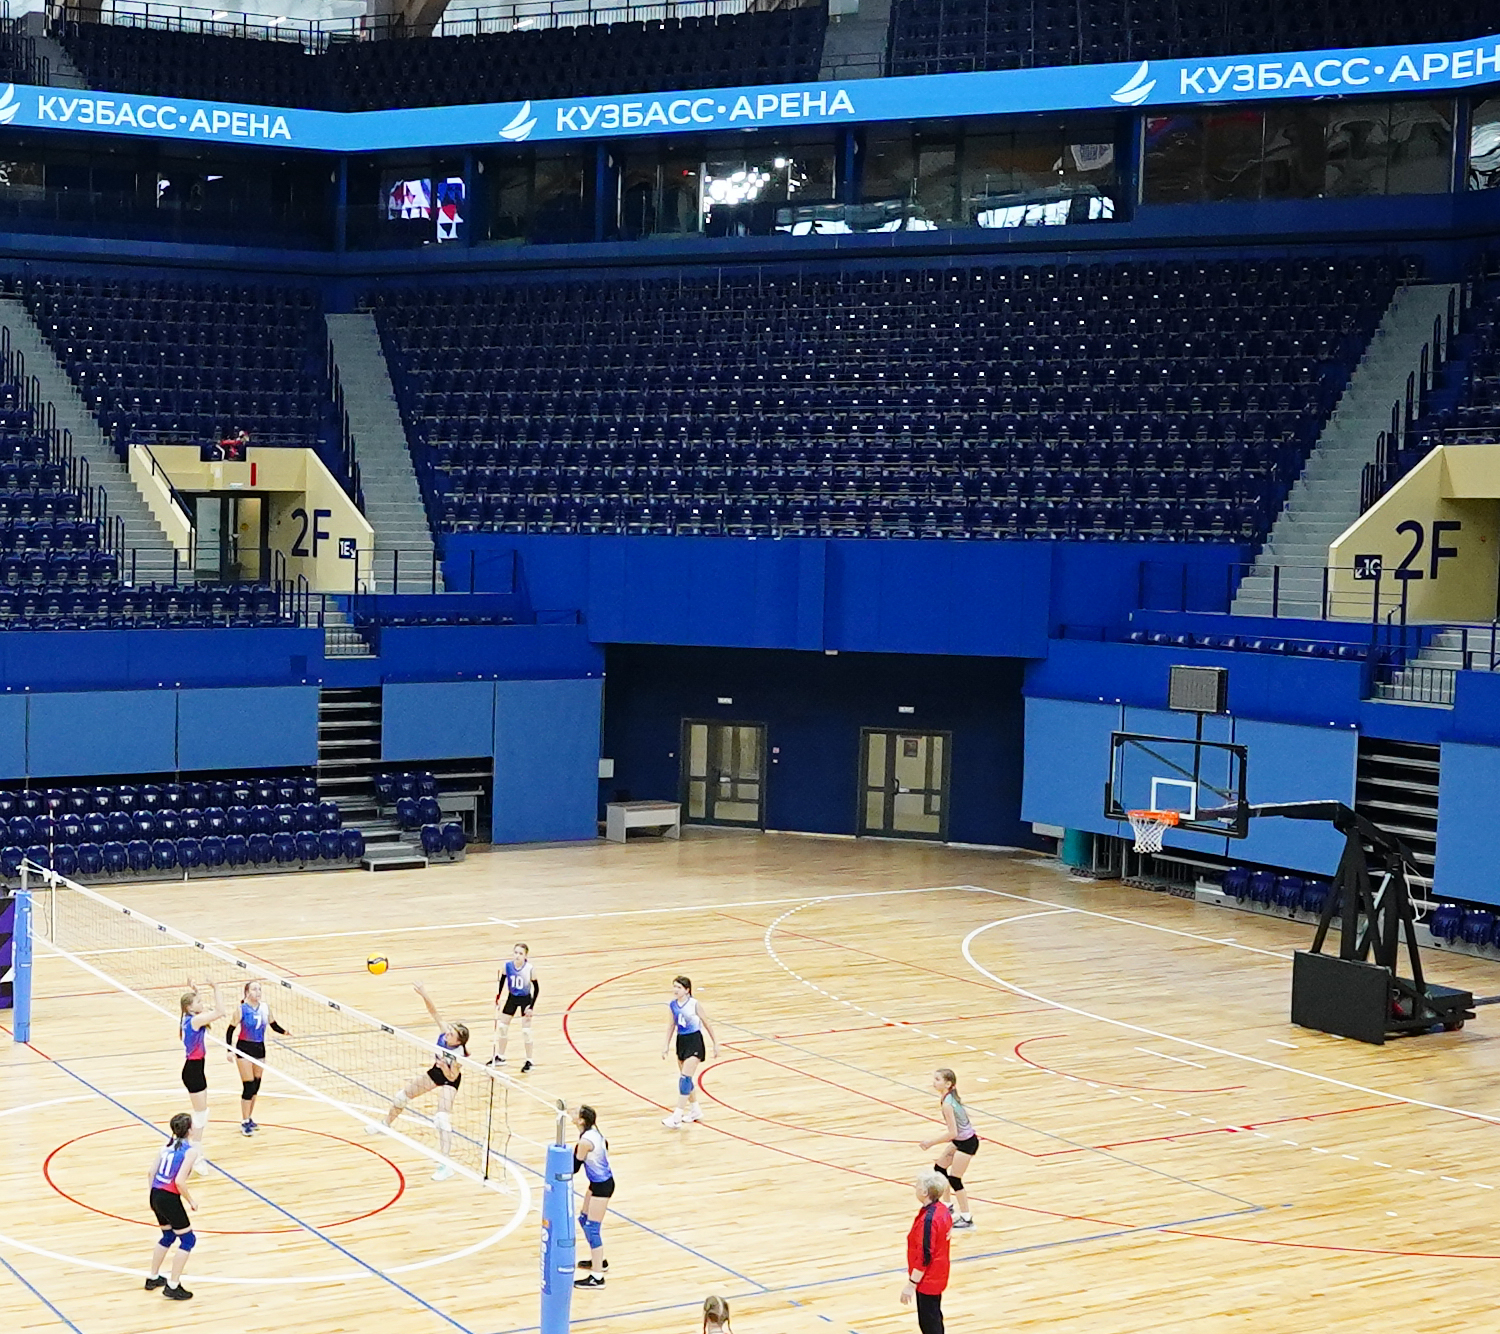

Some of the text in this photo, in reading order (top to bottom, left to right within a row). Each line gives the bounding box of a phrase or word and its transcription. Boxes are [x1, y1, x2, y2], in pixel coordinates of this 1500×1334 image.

[291, 507, 332, 558] 2F
[339, 541, 351, 555] 1E
[1394, 519, 1462, 580] 2F
[510, 974, 524, 990] 10
[253, 1014, 262, 1030] 7
[678, 1013, 687, 1028] 4
[158, 1151, 175, 1177] 11
